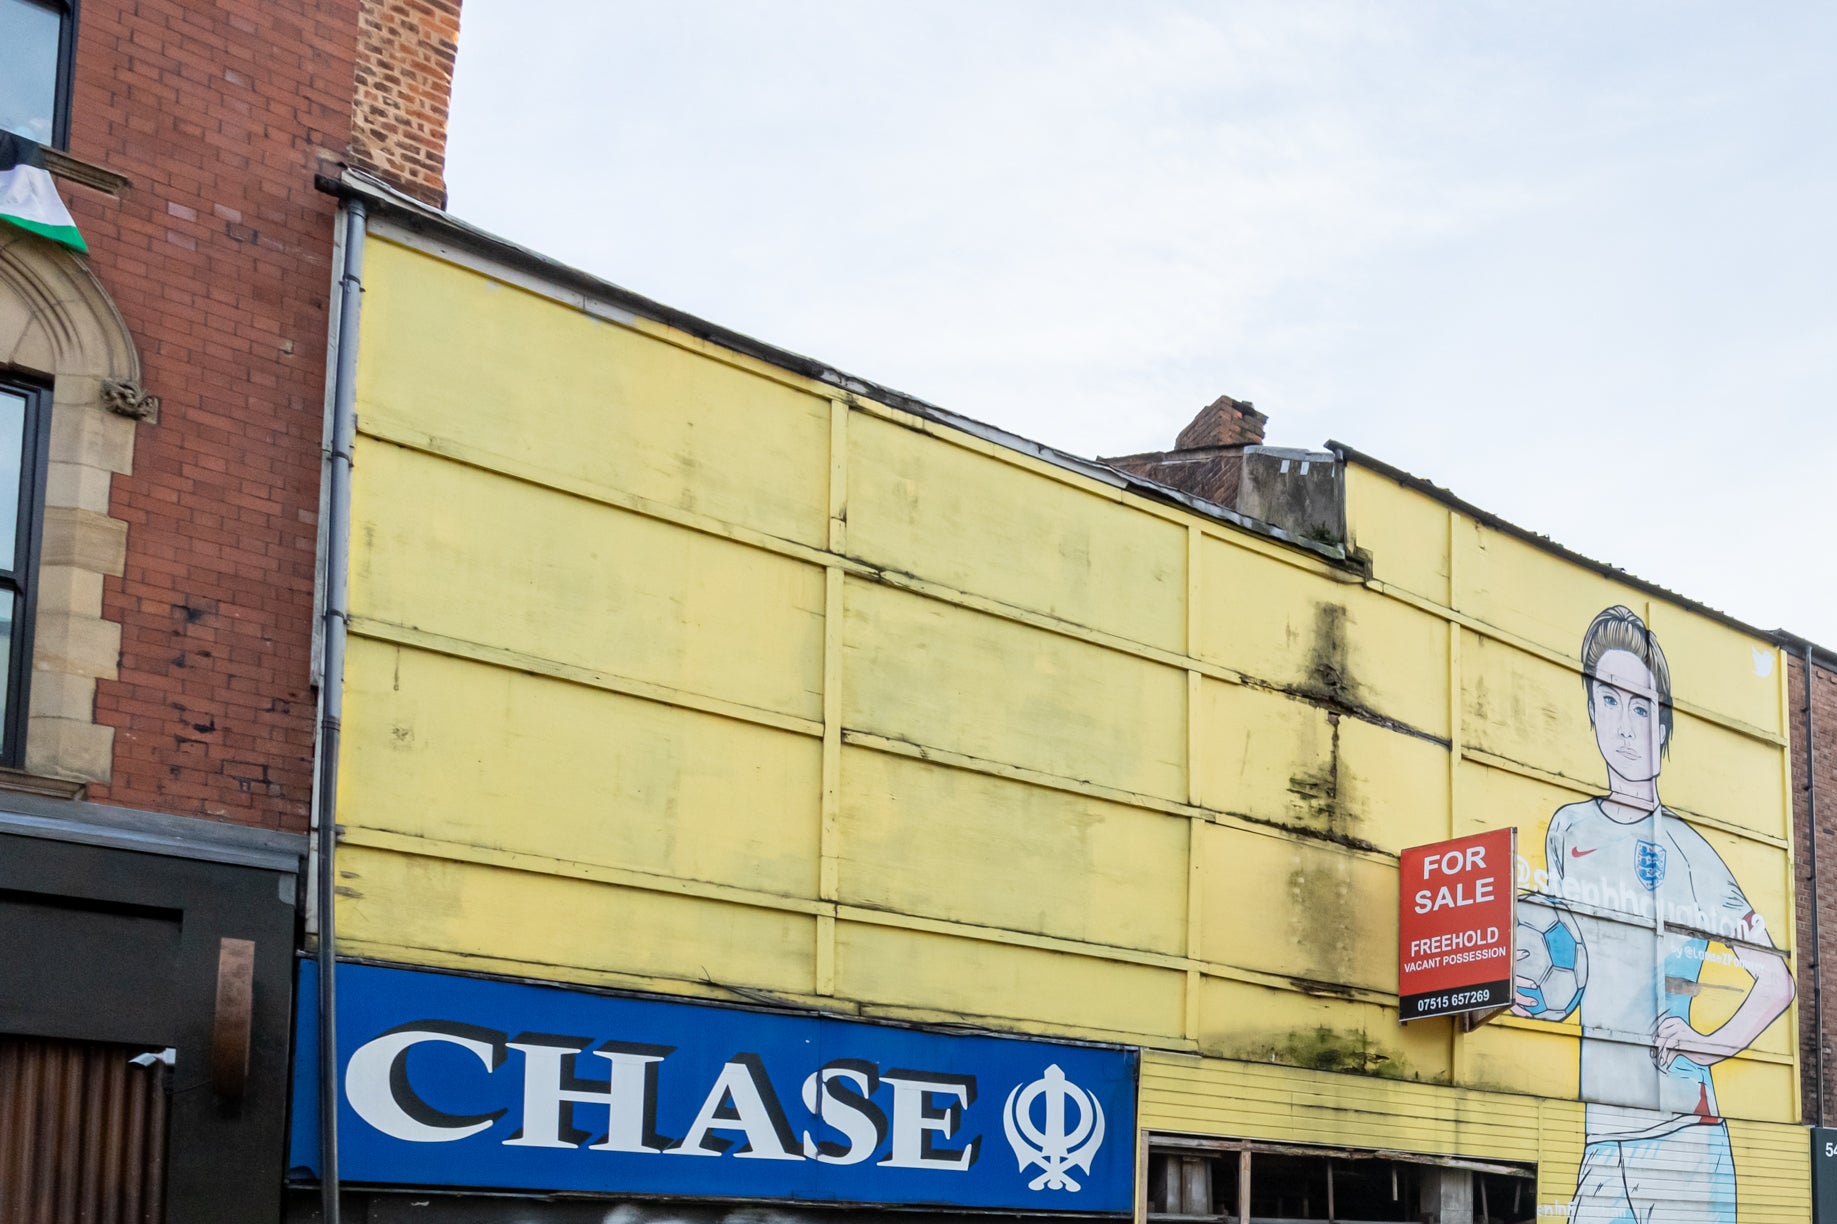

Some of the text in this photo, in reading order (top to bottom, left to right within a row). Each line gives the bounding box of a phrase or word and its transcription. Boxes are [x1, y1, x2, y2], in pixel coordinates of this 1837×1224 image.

[1423, 845, 1486, 880] FOR
[1414, 877, 1495, 915] SALE
[1410, 926, 1499, 957] FREEHOLD
[1404, 946, 1506, 973] VACANT POSSESSION
[1417, 989, 1490, 1012] 07515 657269
[345, 1027, 975, 1172] CHASE
